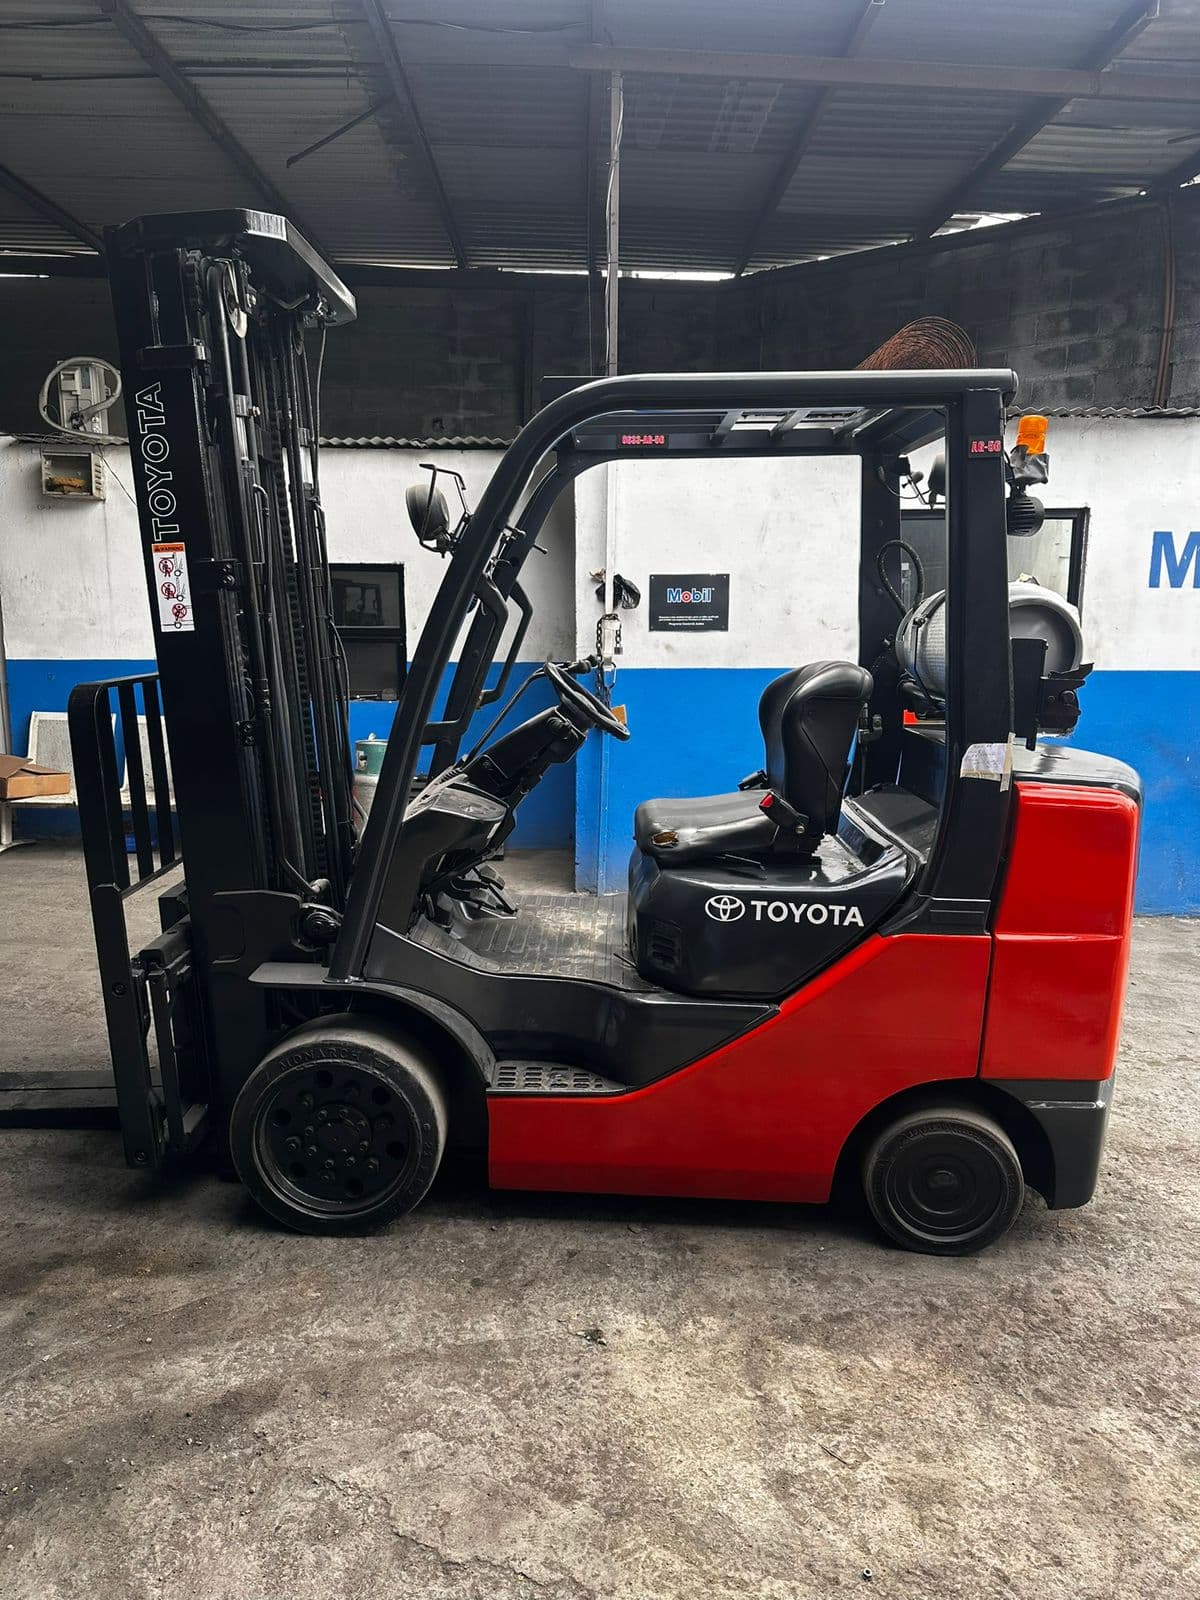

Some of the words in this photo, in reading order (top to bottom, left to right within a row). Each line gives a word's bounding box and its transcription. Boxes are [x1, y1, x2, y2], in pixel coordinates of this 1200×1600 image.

[135, 381, 180, 542] TOYOTA
[666, 587, 712, 603] Mobil
[751, 900, 864, 927] TOYOTA
